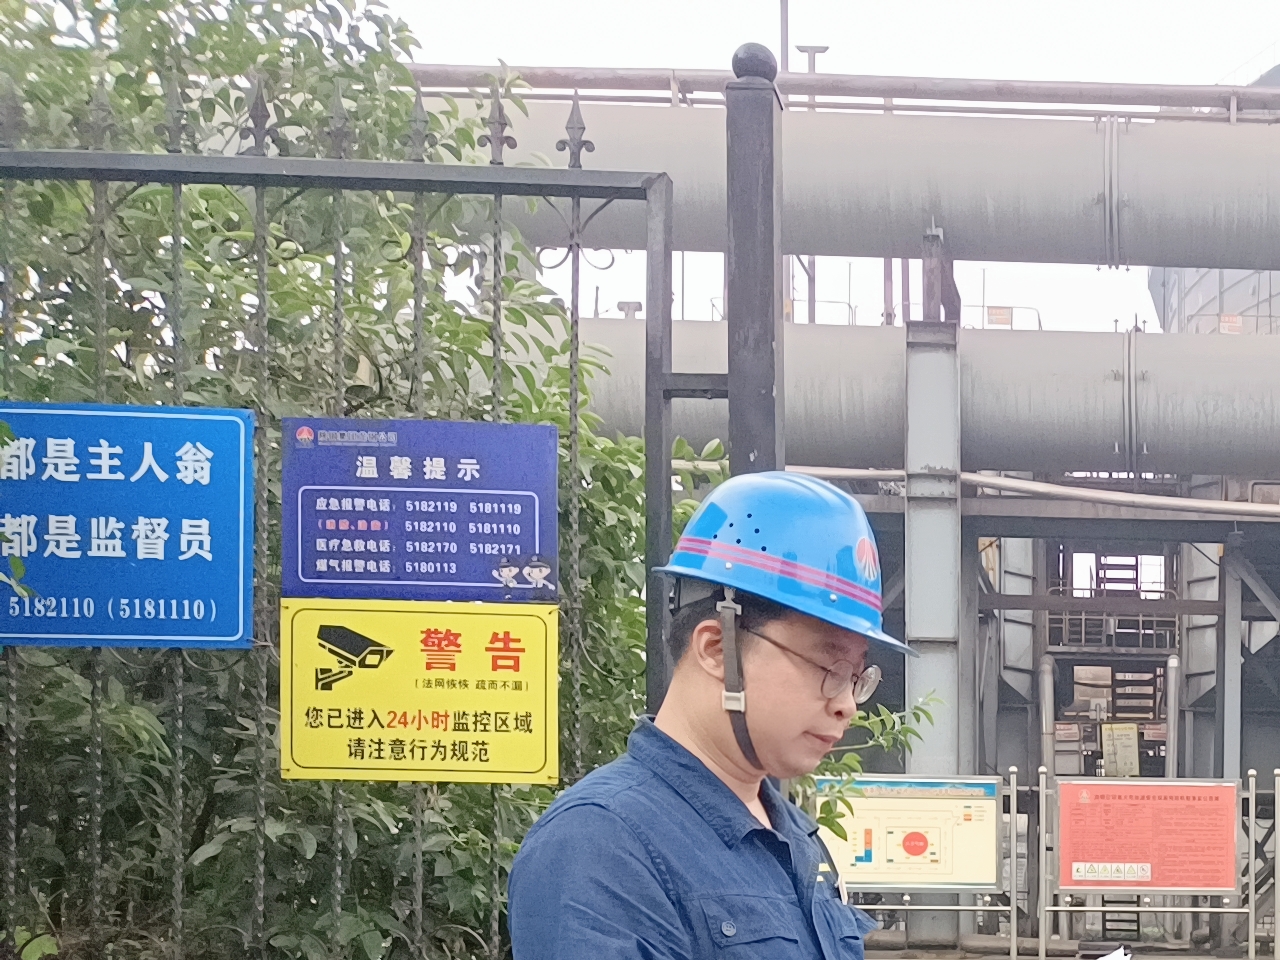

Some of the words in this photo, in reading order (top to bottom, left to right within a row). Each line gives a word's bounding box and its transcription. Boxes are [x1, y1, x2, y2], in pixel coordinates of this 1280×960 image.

[0, 437, 214, 485] 都是主人翁
[356, 456, 481, 482] 温馨提示
[405, 500, 457, 513] 5182119
[469, 503, 522, 515] 5181119
[0, 513, 213, 561] 都是监督员
[405, 521, 456, 533] 5182110
[468, 523, 521, 535] 5181110
[405, 542, 457, 554] 5182170
[469, 543, 521, 555] 5182171
[405, 562, 457, 574] 5180113
[420, 628, 526, 673] 警告
[304, 706, 533, 734] 您已进入24小时监控区域
[347, 738, 490, 763] 请注意行为规范
